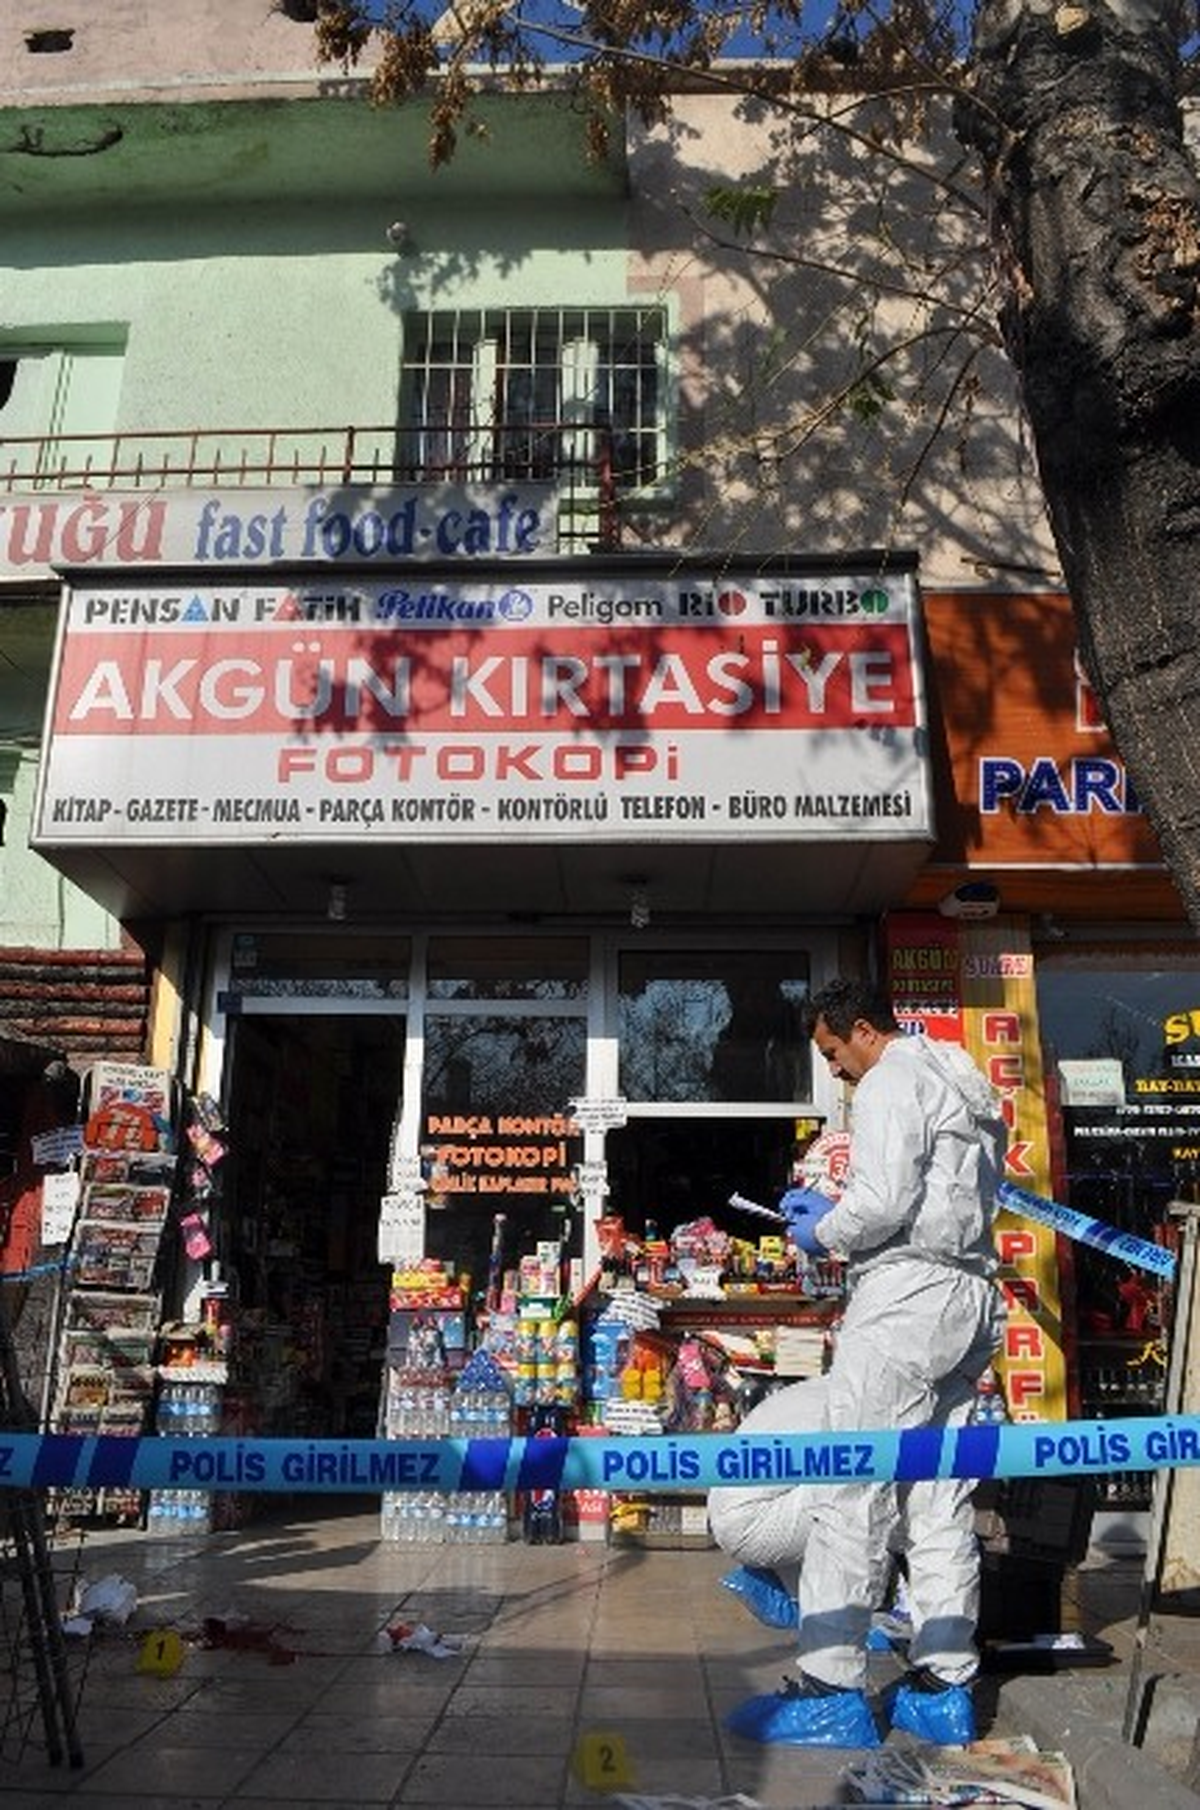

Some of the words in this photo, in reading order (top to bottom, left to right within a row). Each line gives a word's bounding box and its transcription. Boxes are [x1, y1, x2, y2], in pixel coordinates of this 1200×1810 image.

[194, 499, 288, 562] fast
[301, 493, 541, 558] food-cafe
[83, 594, 240, 625] PENSAN
[376, 589, 495, 622] Pelikan
[548, 592, 663, 624] Peligom
[759, 588, 889, 616] TURBO
[68, 641, 412, 721] AKGÜN
[449, 639, 896, 718] KIRTASİYE
[277, 744, 679, 784] FOTOKOPİ
[52, 797, 112, 823] KİTAP
[126, 798, 198, 823] GAZETE
[212, 799, 301, 823] MECMUA
[319, 799, 385, 830] PARÇA
[391, 792, 475, 821] KONTÖR
[498, 791, 608, 821] KONTÖRLÜ
[620, 796, 705, 820] TELEFON
[728, 790, 787, 819] BÜRO
[794, 790, 912, 818] MALZEMESİ
[169, 1443, 266, 1483] POLİS
[281, 1444, 442, 1484] GİRİLMEZ
[603, 1442, 700, 1482] POLİS
[716, 1440, 876, 1480] GİRİLMEZ
[1034, 1426, 1131, 1468] POLİS
[155, 1639, 166, 1661] 1
[599, 1745, 618, 1773] 2
